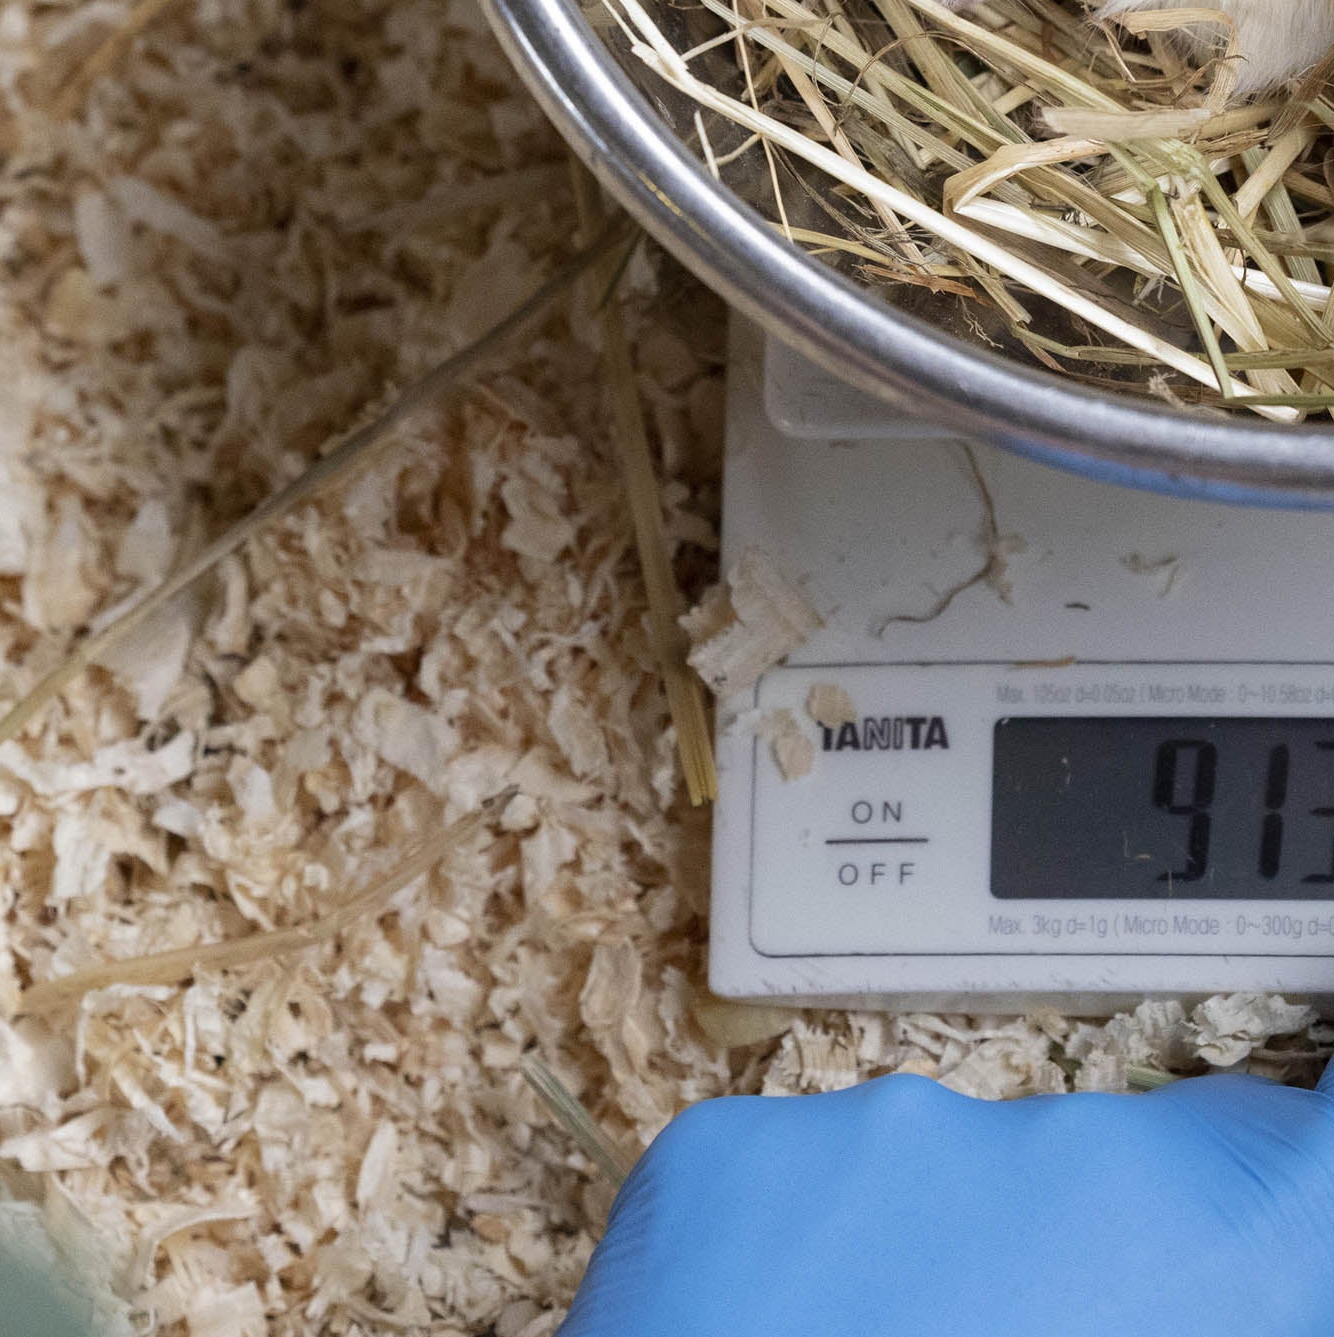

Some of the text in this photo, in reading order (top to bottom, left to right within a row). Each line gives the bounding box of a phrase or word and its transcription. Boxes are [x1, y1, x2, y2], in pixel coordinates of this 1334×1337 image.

[851, 800, 902, 824] ON
[838, 862, 915, 885] OFF
[988, 915, 1024, 935] Max.
[1032, 915, 1061, 938] 3kg
[1067, 915, 1108, 938] d=1g
[1124, 915, 1168, 935] Micro
[1173, 915, 1220, 936] Mode
[1236, 915, 1303, 939] 0~300g
